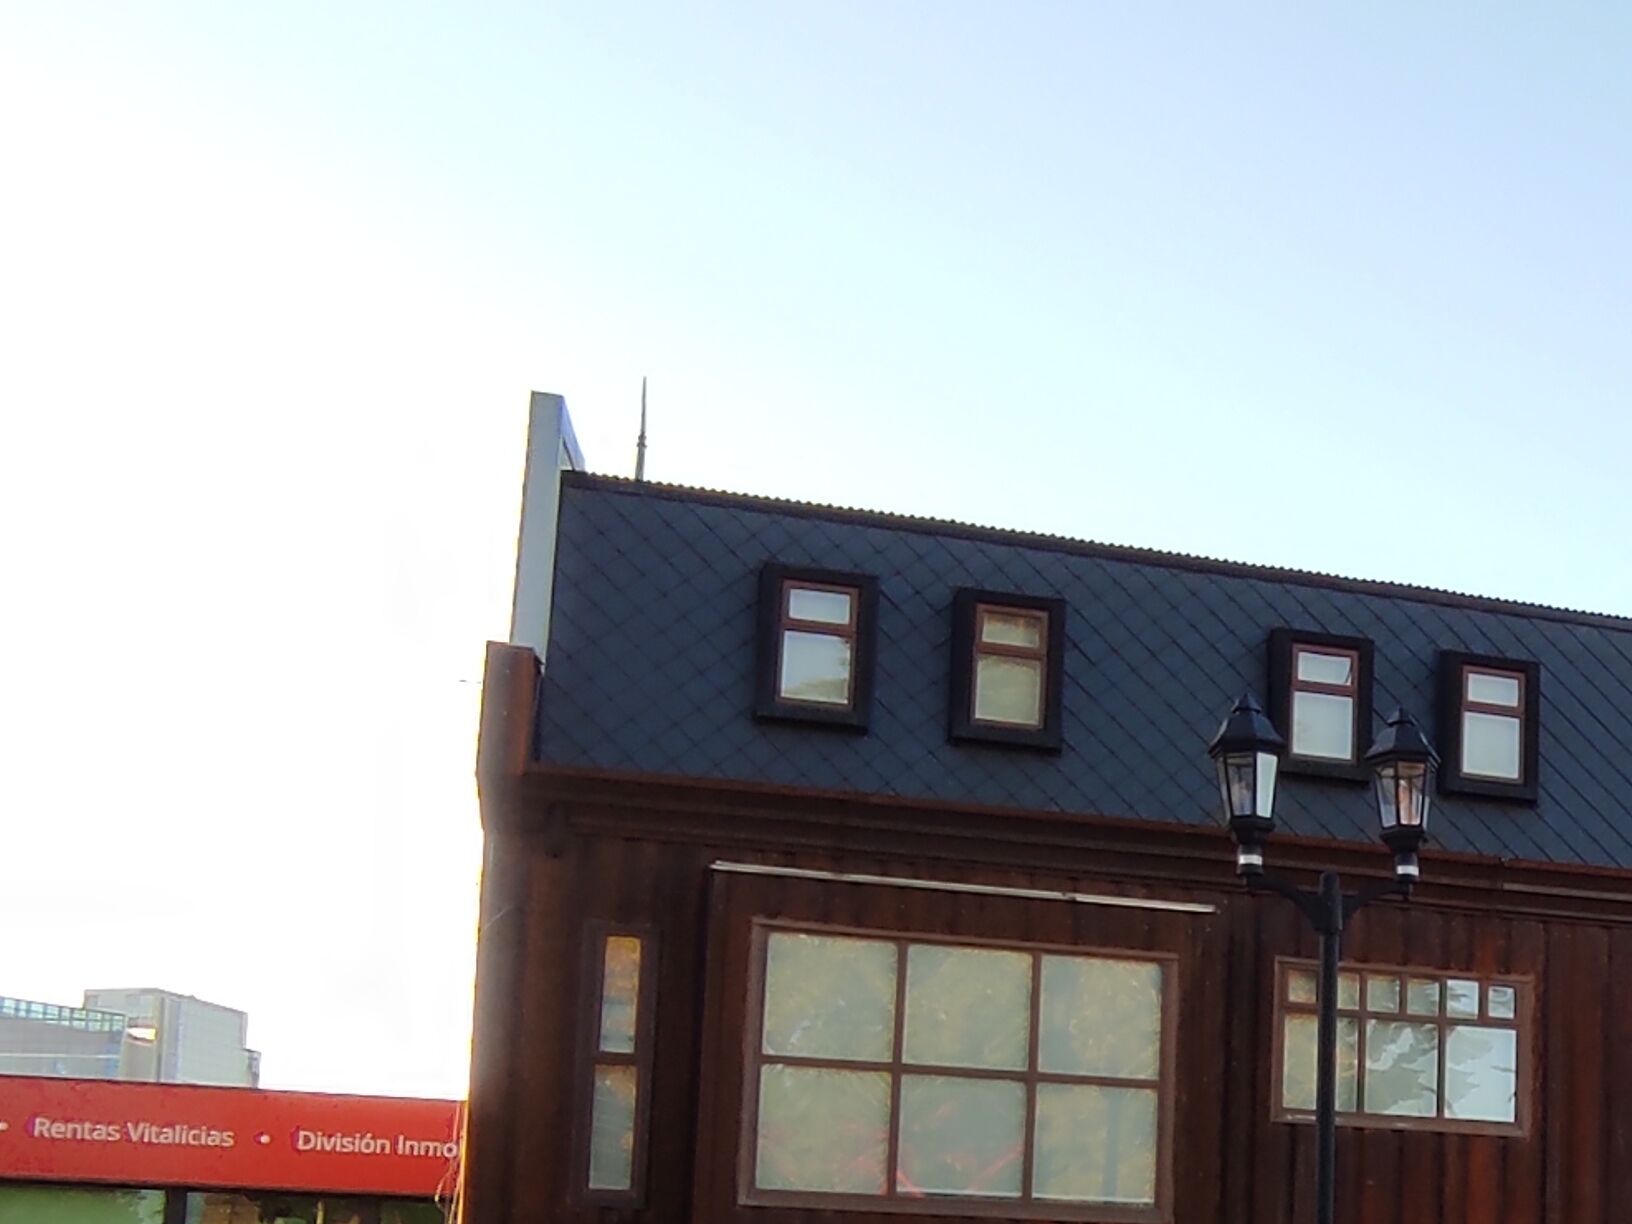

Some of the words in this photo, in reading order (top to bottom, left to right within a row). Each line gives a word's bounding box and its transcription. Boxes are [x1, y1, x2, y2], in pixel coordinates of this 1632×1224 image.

[33, 1116, 121, 1142] Rentas
[126, 1122, 235, 1148] Vitalicias
[297, 1130, 390, 1155] División
